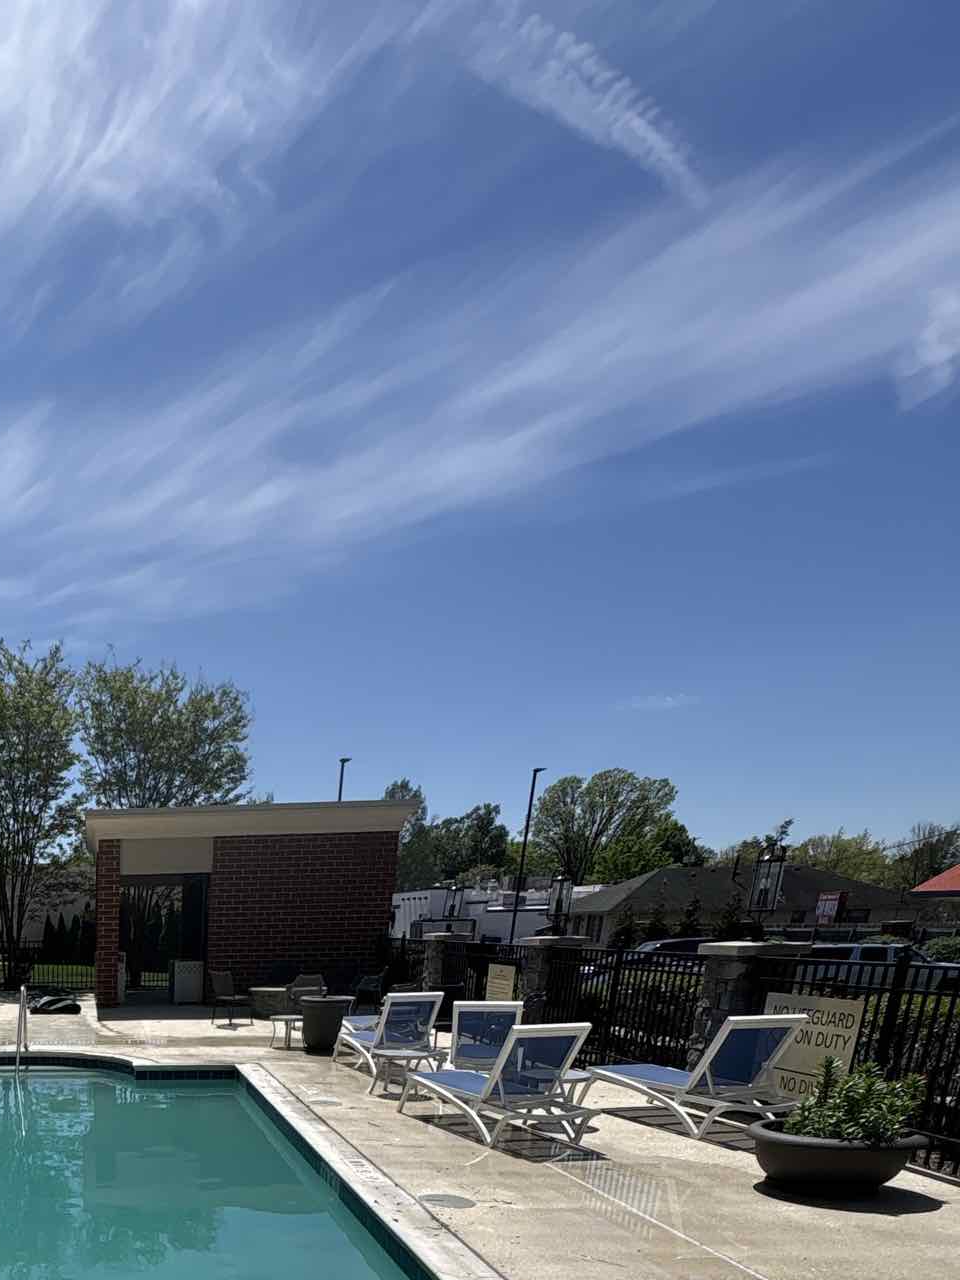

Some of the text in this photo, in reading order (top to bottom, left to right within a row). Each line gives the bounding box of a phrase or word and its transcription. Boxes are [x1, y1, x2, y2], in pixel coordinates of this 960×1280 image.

[795, 1028, 852, 1052] ON DUTY
[780, 1075, 797, 1092] NO
